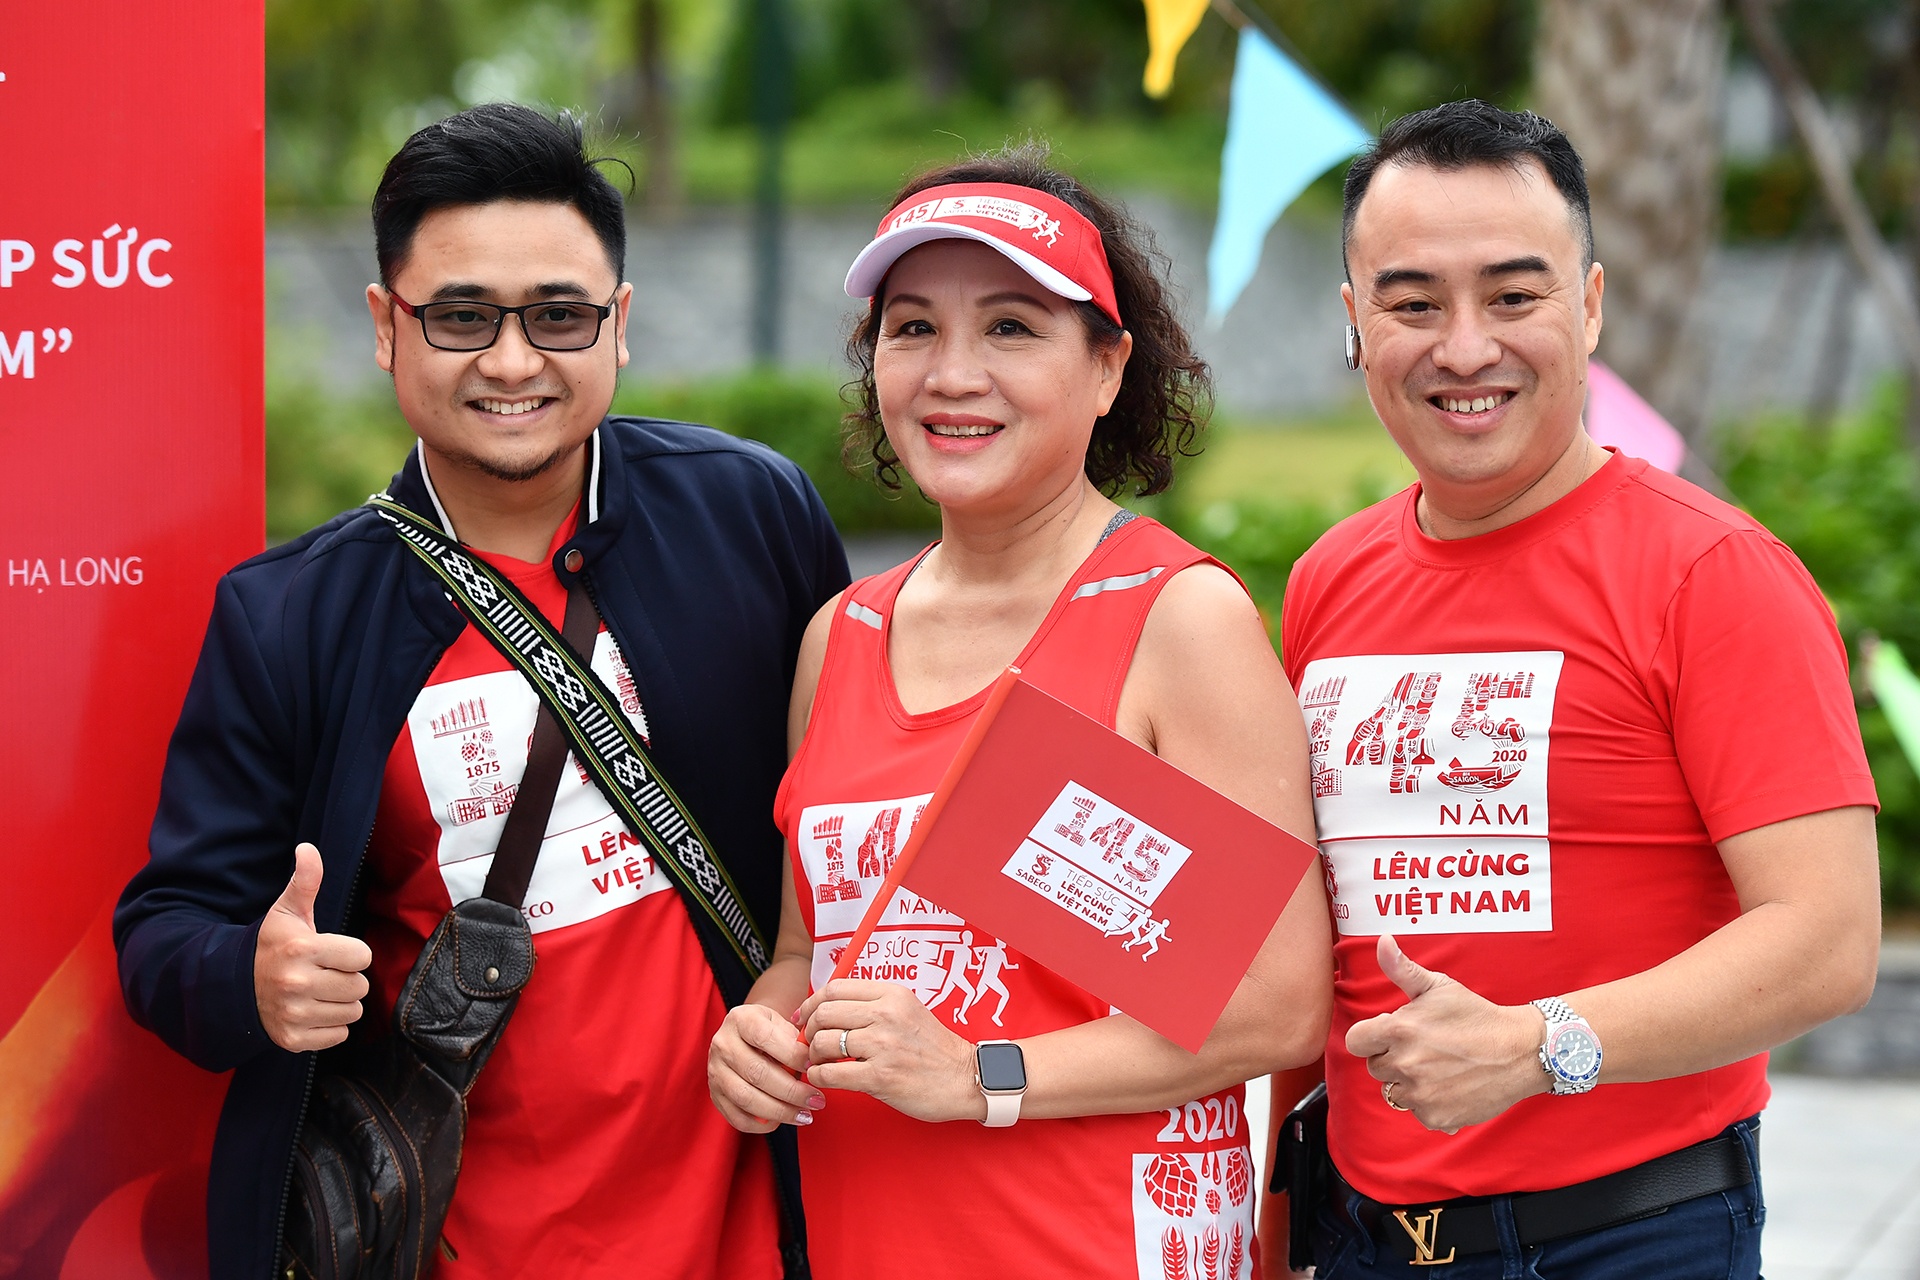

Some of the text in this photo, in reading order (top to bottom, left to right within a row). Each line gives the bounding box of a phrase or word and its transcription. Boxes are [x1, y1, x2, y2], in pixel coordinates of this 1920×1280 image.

[895, 203, 930, 229] 145
[997, 212, 1020, 223] NAM
[52, 223, 173, 289] SỨC
[9, 557, 144, 594] HẠ LONG
[1308, 738, 1330, 756] 1875
[1491, 749, 1528, 762] 2020
[465, 760, 501, 779] 1875
[1440, 798, 1529, 826] NĂM
[581, 831, 641, 866] LÊN
[826, 860, 845, 872] 1875
[1373, 848, 1530, 880] LÊN CÙNG
[1015, 868, 1052, 893] SABECO
[1066, 868, 1121, 907] TIẾP SỨC
[1113, 872, 1148, 898] NĂM
[1056, 890, 1109, 927] VIỆT NAM
[1060, 880, 1114, 916] LÊN CÙNG
[1374, 887, 1530, 924] VIỆT NAM
[884, 935, 920, 958] SỨC
[874, 960, 919, 981] CÙNG
[1156, 1094, 1239, 1143] 2020
